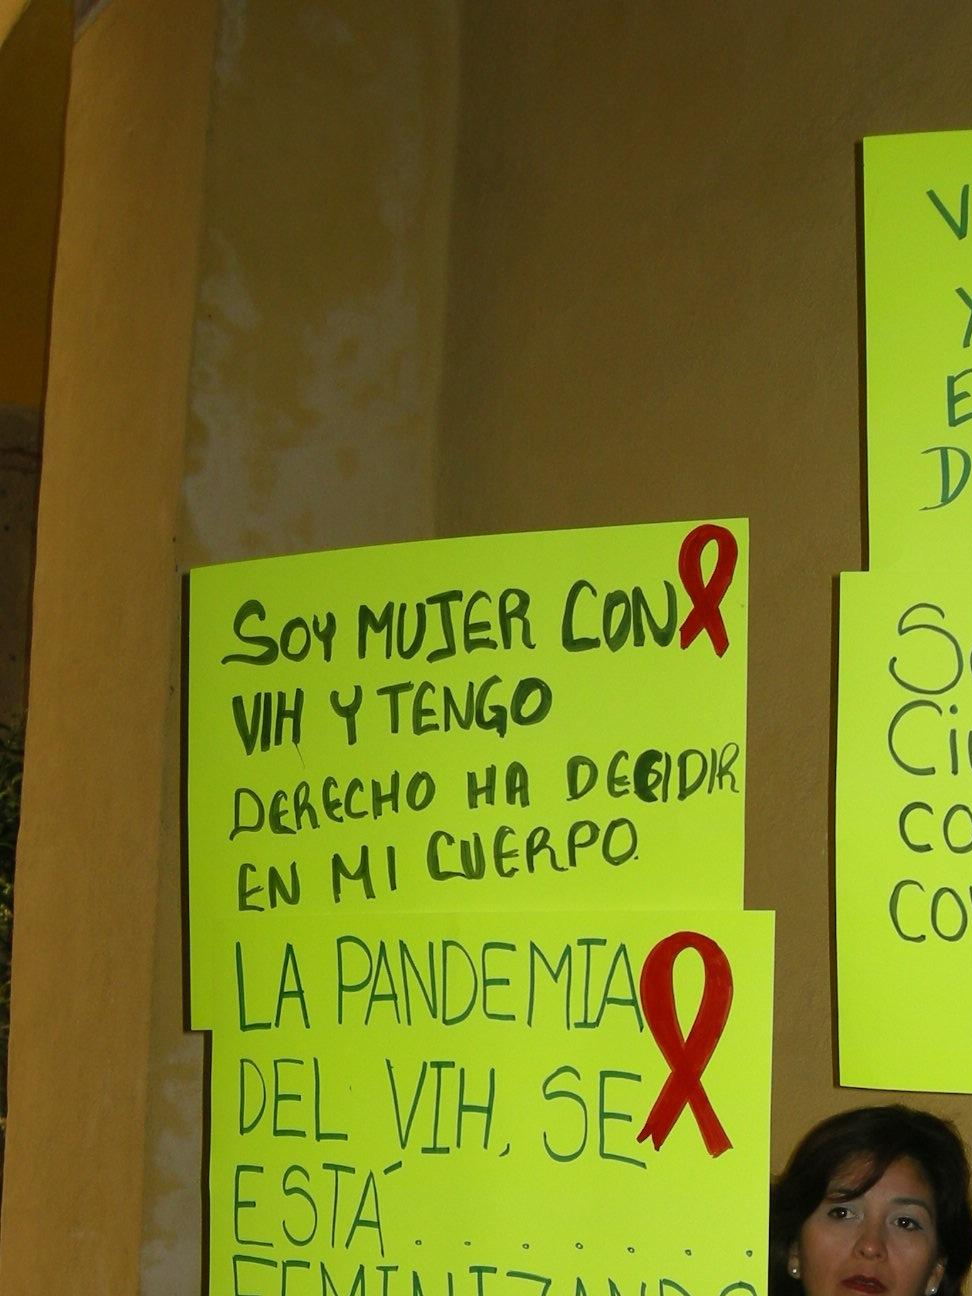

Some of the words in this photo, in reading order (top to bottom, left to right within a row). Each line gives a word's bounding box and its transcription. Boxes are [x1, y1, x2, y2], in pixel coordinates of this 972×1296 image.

[221, 600, 336, 665] SOY
[358, 588, 536, 663] MUJER
[562, 580, 677, 652] CON
[232, 688, 304, 755] VIH
[330, 685, 362, 745] Y
[377, 675, 552, 738] TENGO
[229, 771, 435, 841] DERECHO
[467, 761, 529, 809] HA
[567, 743, 739, 803] DECIDIR
[238, 861, 300, 912] EN
[332, 845, 397, 903] MI
[236, 941, 310, 1032] LA
[337, 935, 643, 1032] PANDEMIA
[240, 1057, 348, 1142] DEL
[386, 1059, 510, 1157] VIH,
[542, 1066, 647, 1169] SE
